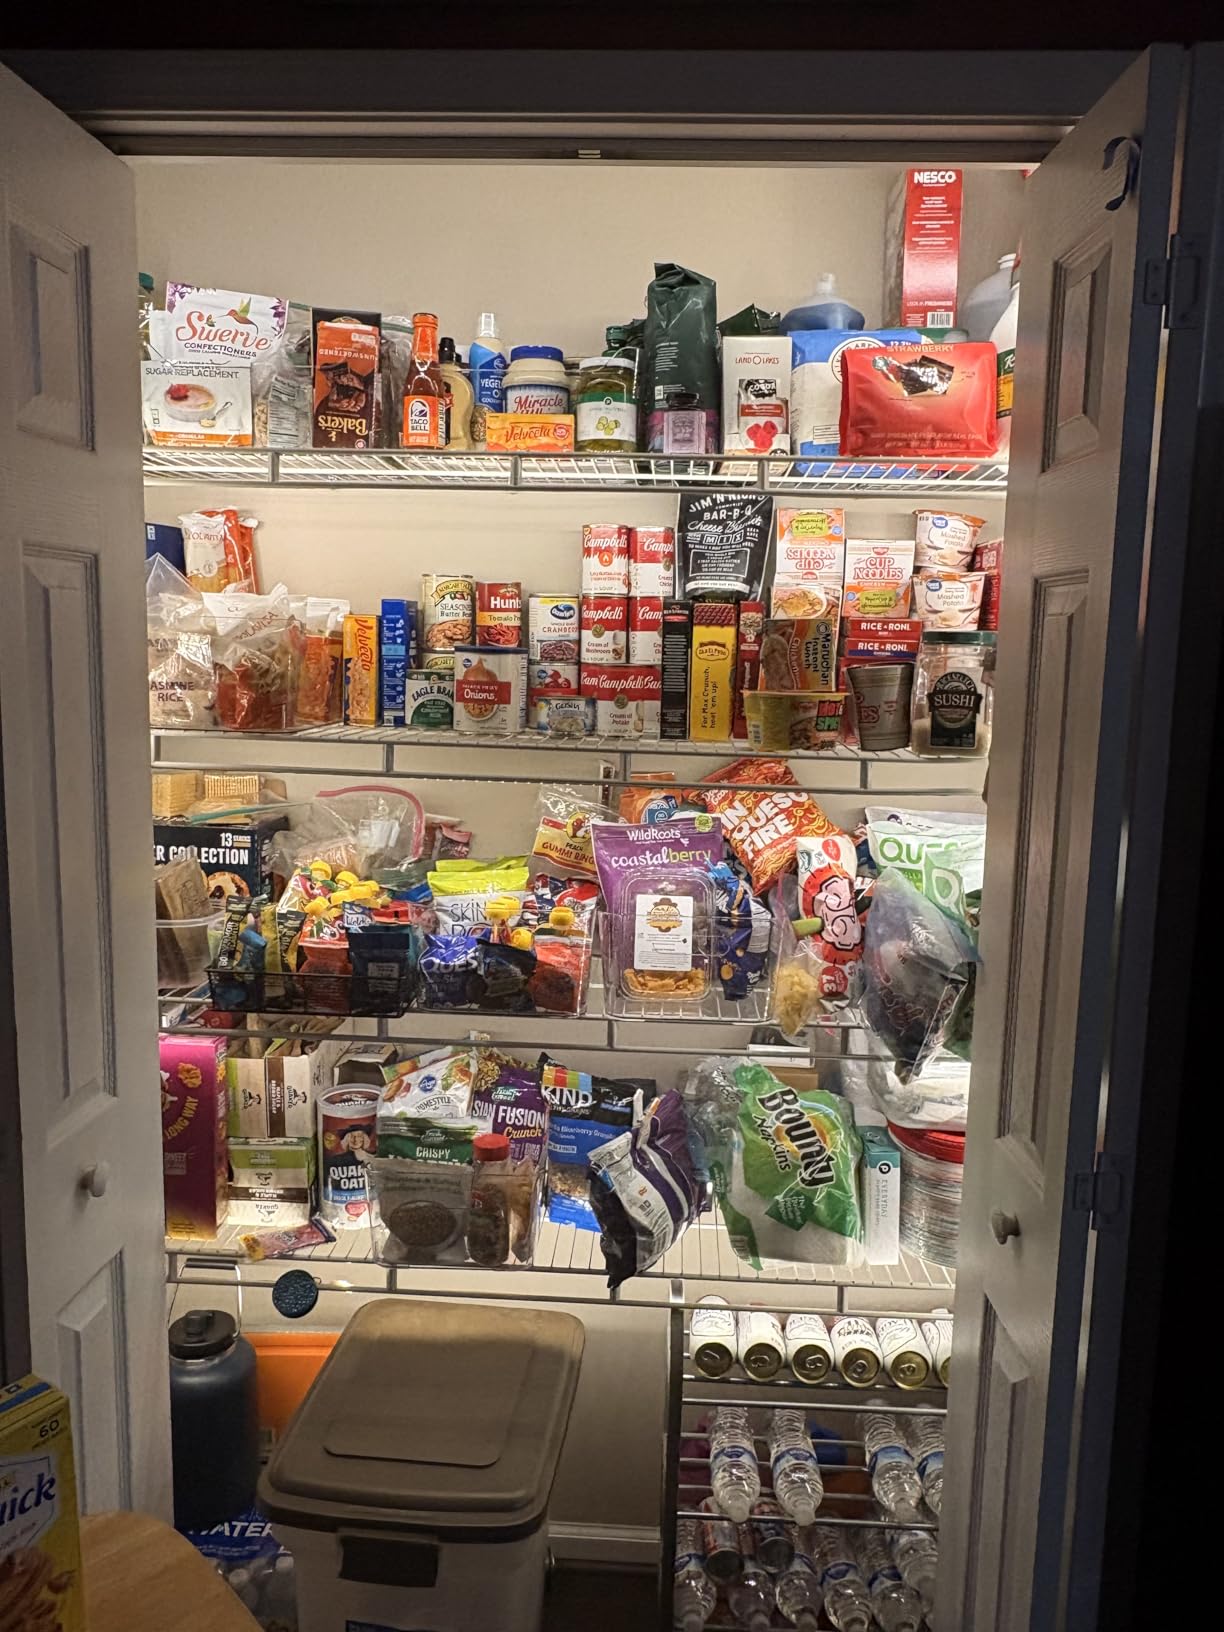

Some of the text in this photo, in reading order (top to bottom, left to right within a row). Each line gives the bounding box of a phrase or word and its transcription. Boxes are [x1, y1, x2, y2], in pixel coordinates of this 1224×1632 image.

[914, 171, 957, 184] NESCO
[175, 310, 271, 351] Swerve
[184, 342, 257, 358] CONFECTIONERS
[145, 367, 240, 379] SUGAR REPLACEMENT
[514, 393, 564, 413] Miracle
[688, 496, 713, 513] JIM
[703, 505, 752, 521] BAR-B-Q
[687, 520, 723, 533] Cheese
[786, 547, 836, 560] NOODLES
[795, 559, 824, 570] CUP
[865, 557, 895, 568] CUP
[853, 568, 903, 580] NOODLES
[860, 622, 883, 630] RICE
[857, 642, 880, 650] RICE
[804, 641, 812, 669] Lunch
[812, 637, 820, 673] Instant
[821, 633, 831, 686] Maruchan
[157, 693, 184, 702] RICE
[411, 685, 435, 702] EAGLE
[464, 689, 495, 700] Onions
[934, 694, 975, 707] SUSHI
[721, 799, 749, 830] IN
[220, 832, 232, 847] 13
[626, 828, 681, 841] WildRoots
[742, 813, 794, 859] FIRE
[542, 842, 573, 859] GUMMI
[880, 836, 959, 864] QU
[541, 1086, 593, 1107] KIND
[164, 1096, 199, 1140] LONG WAY
[497, 1106, 545, 1128] FUSION
[504, 1127, 543, 1139] Crunch
[752, 1113, 792, 1172] Napkins
[416, 1147, 450, 1159] CRISPY
[39, 1418, 60, 1439] 60
[200, 1521, 273, 1537] ATER
